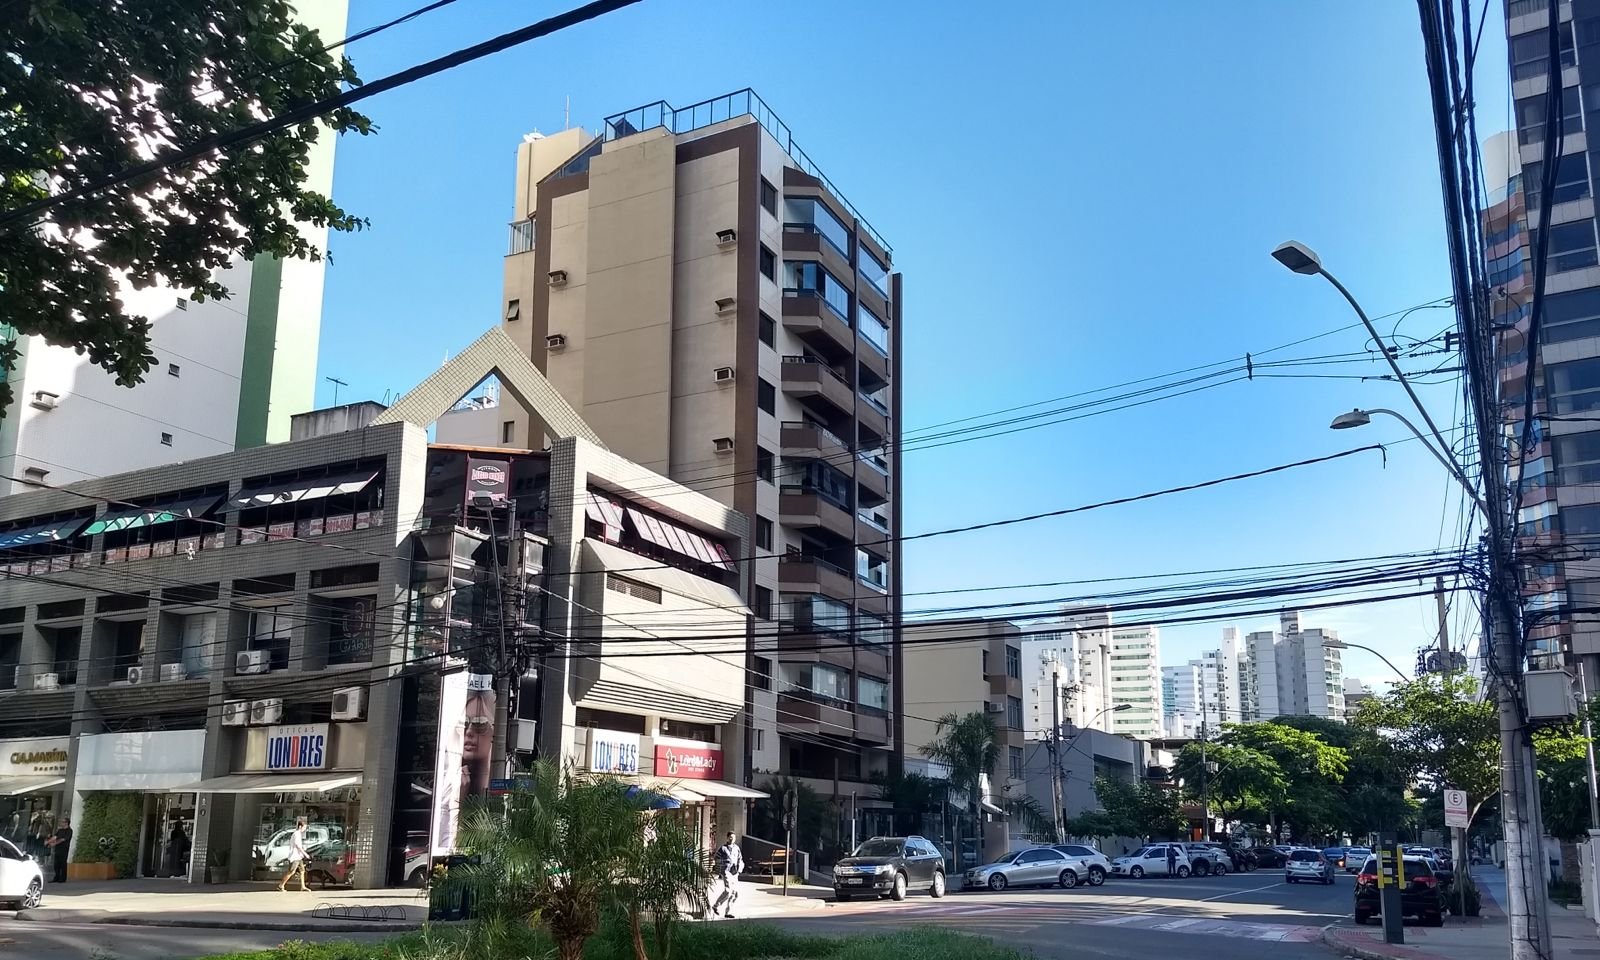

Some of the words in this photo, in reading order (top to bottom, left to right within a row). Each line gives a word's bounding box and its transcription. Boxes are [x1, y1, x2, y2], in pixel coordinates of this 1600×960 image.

[268, 735, 324, 769] LONDRES
[595, 740, 636, 772] LONDRES
[1452, 793, 1459, 803] E
